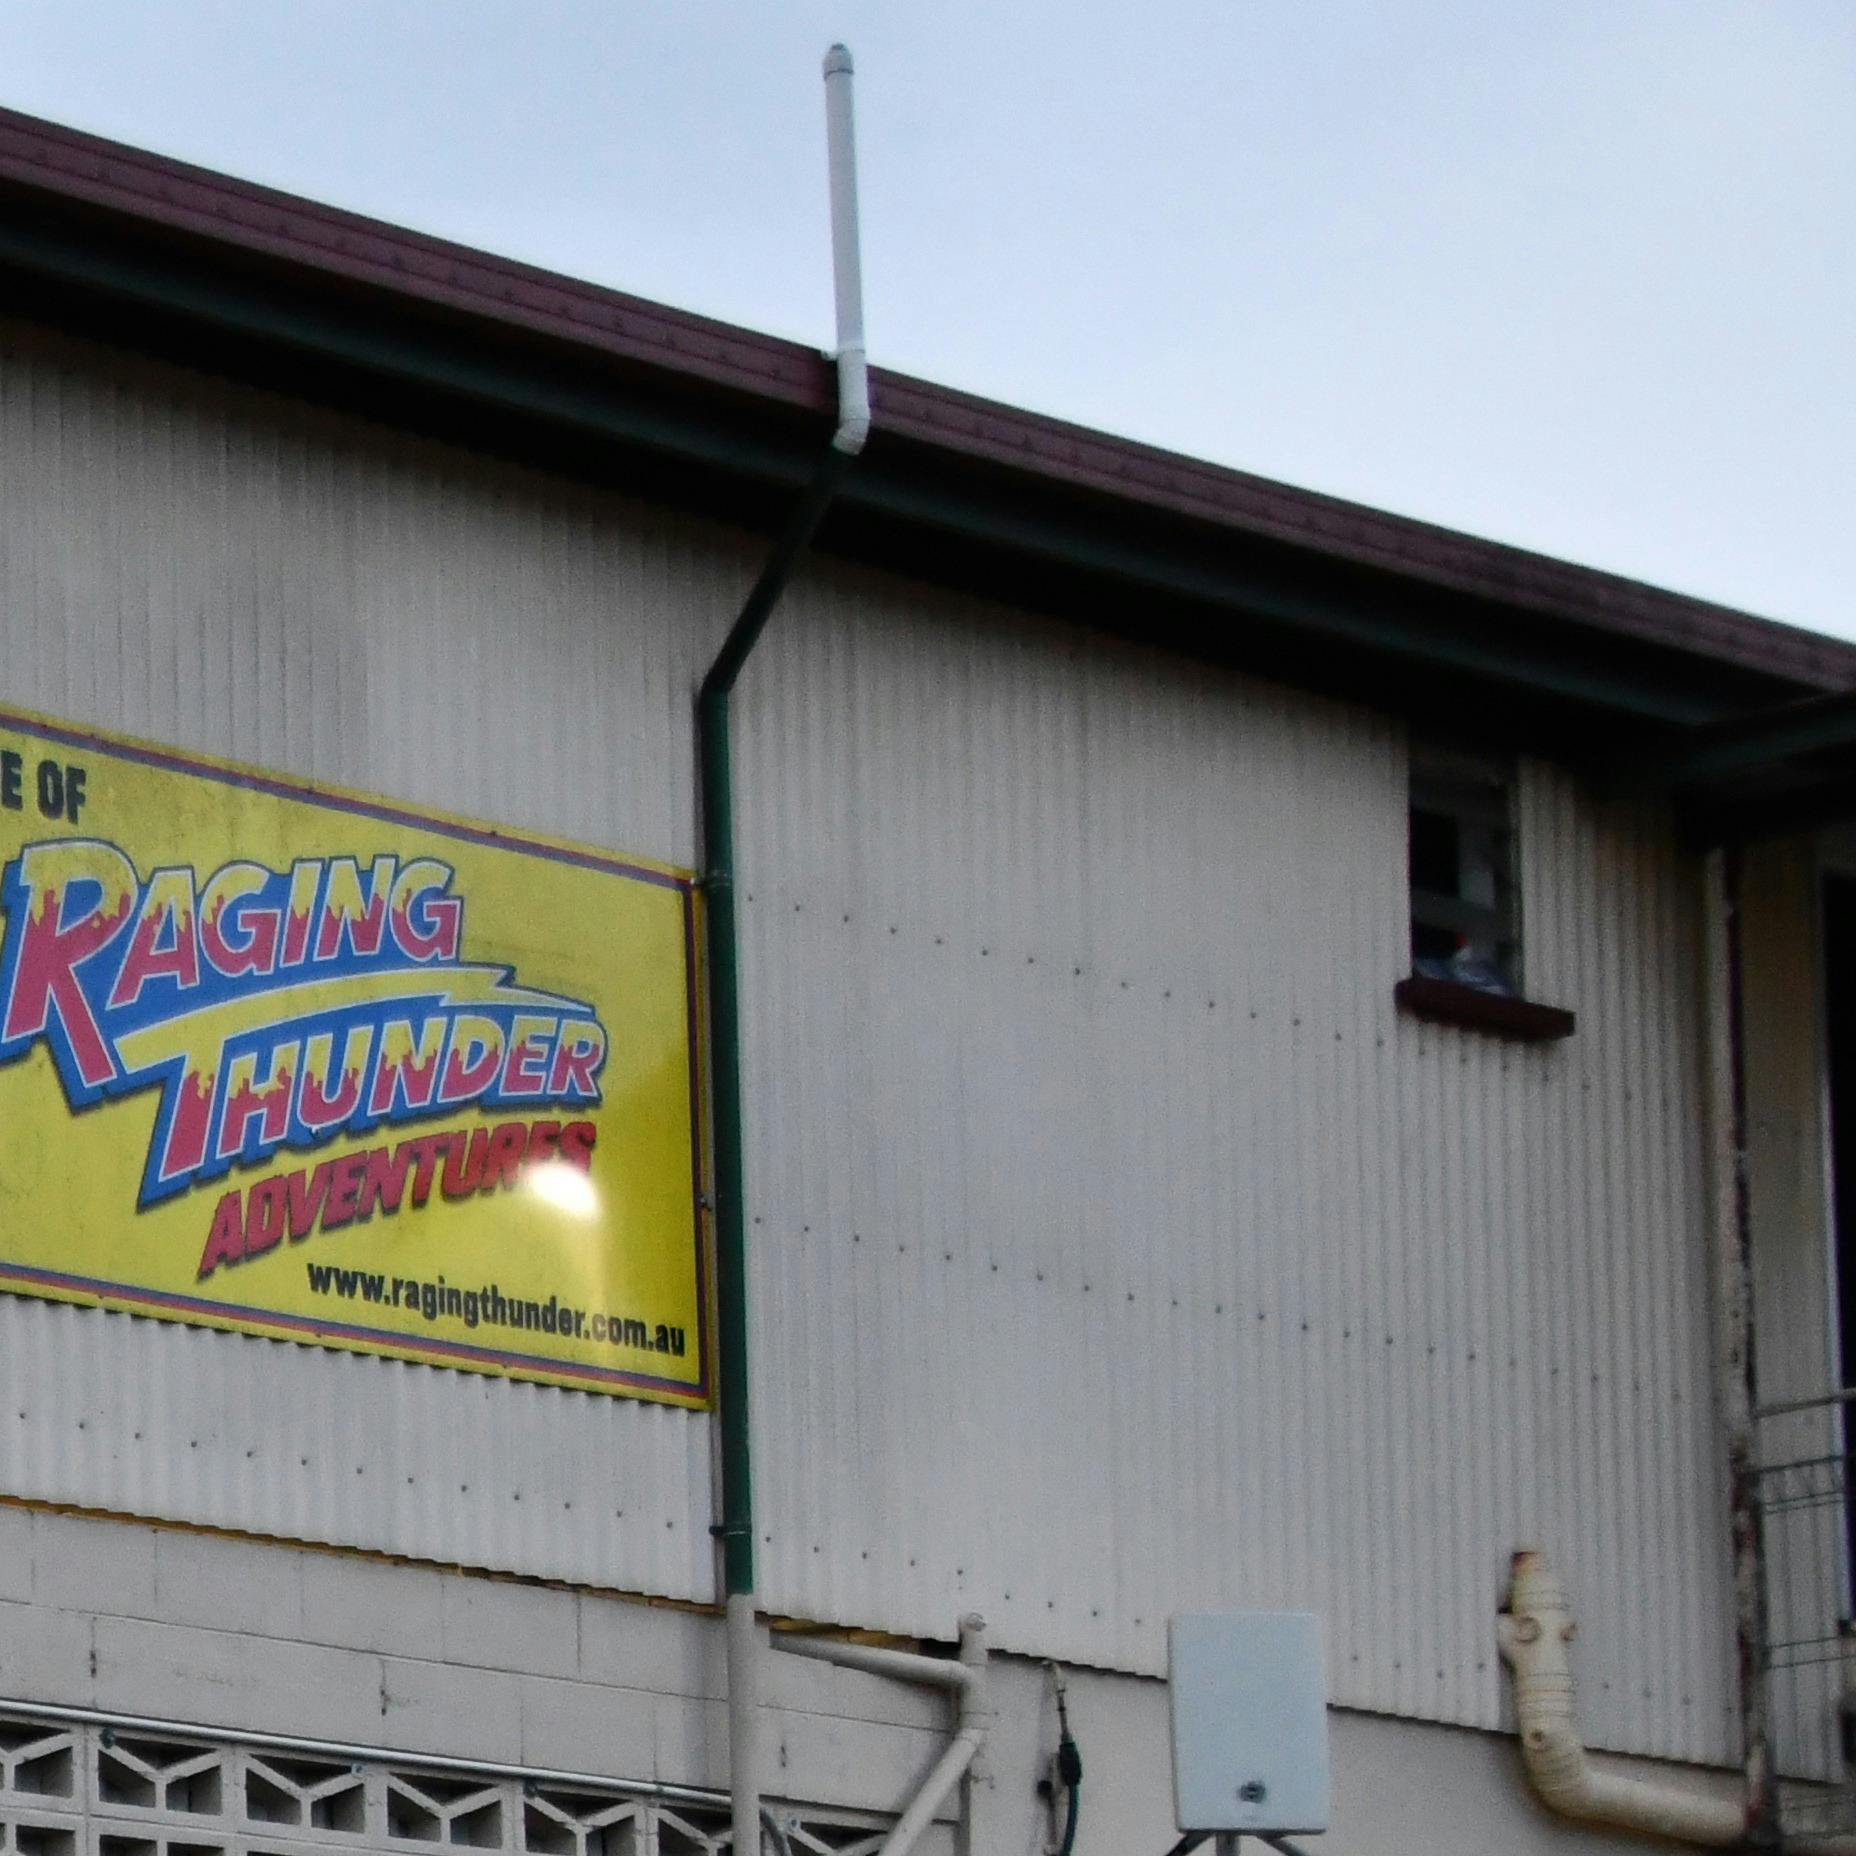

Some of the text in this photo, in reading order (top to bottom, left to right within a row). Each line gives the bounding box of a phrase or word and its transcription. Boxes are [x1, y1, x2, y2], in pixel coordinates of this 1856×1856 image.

[37, 763, 87, 822] OF
[0, 837, 463, 1090] RAGING
[116, 1012, 605, 1183] THUNDER
[307, 1261, 686, 1357] www.ragingthunder.com.au
